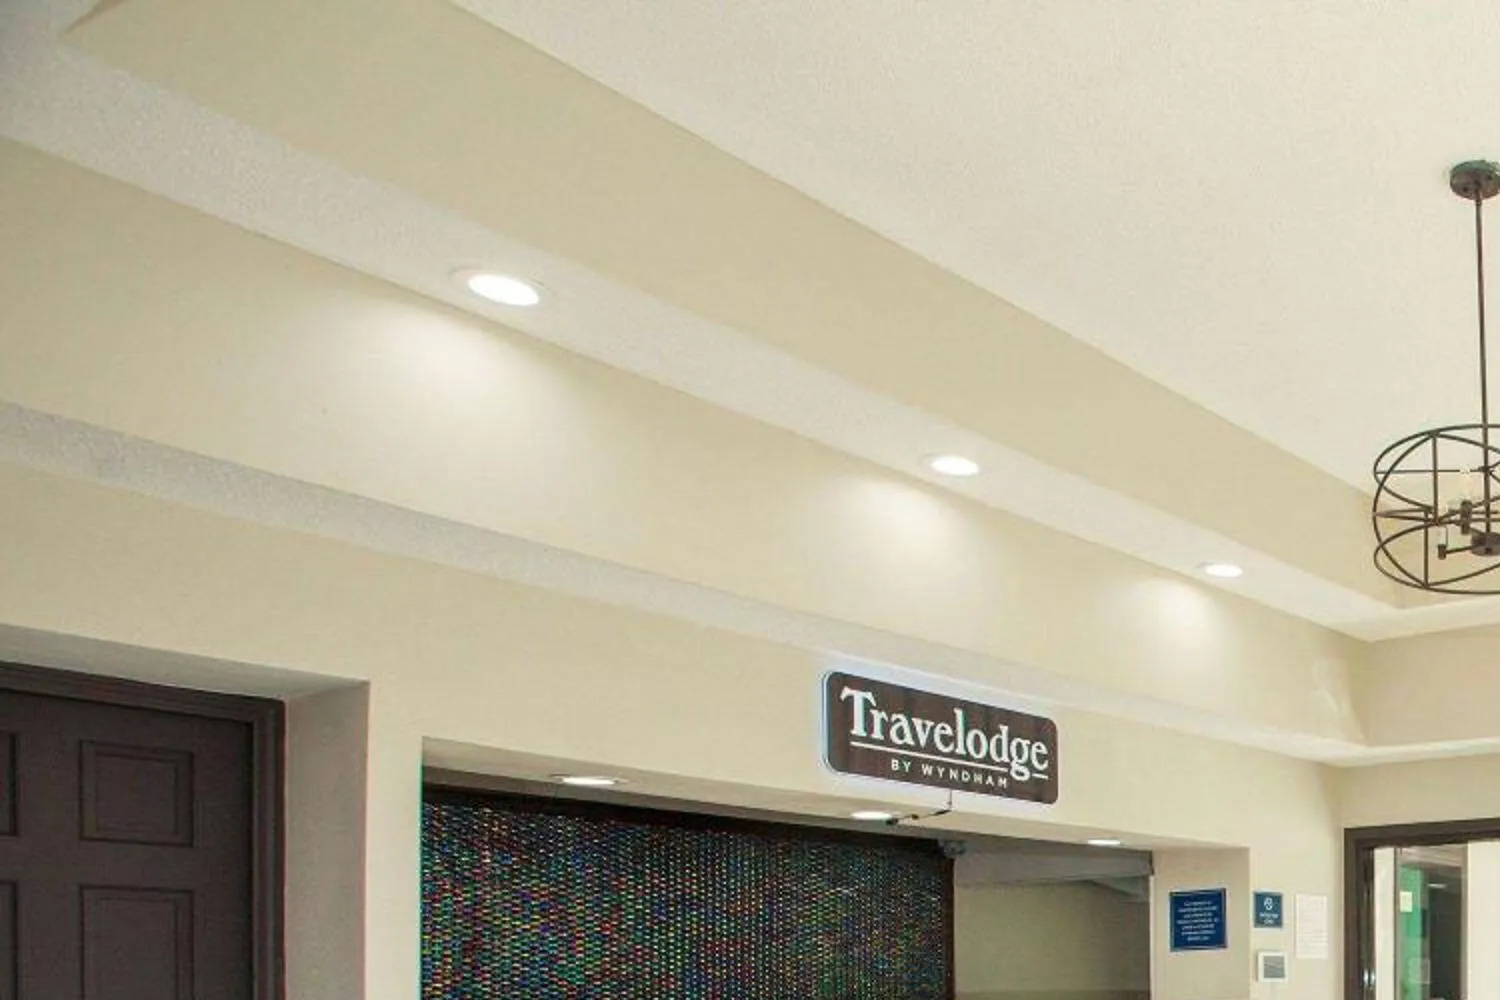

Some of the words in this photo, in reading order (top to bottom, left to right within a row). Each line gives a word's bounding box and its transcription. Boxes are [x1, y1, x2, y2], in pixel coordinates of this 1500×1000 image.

[840, 686, 1049, 781] Travelodge
[891, 759, 912, 773] BY
[921, 763, 1008, 788] WYNDHAM
